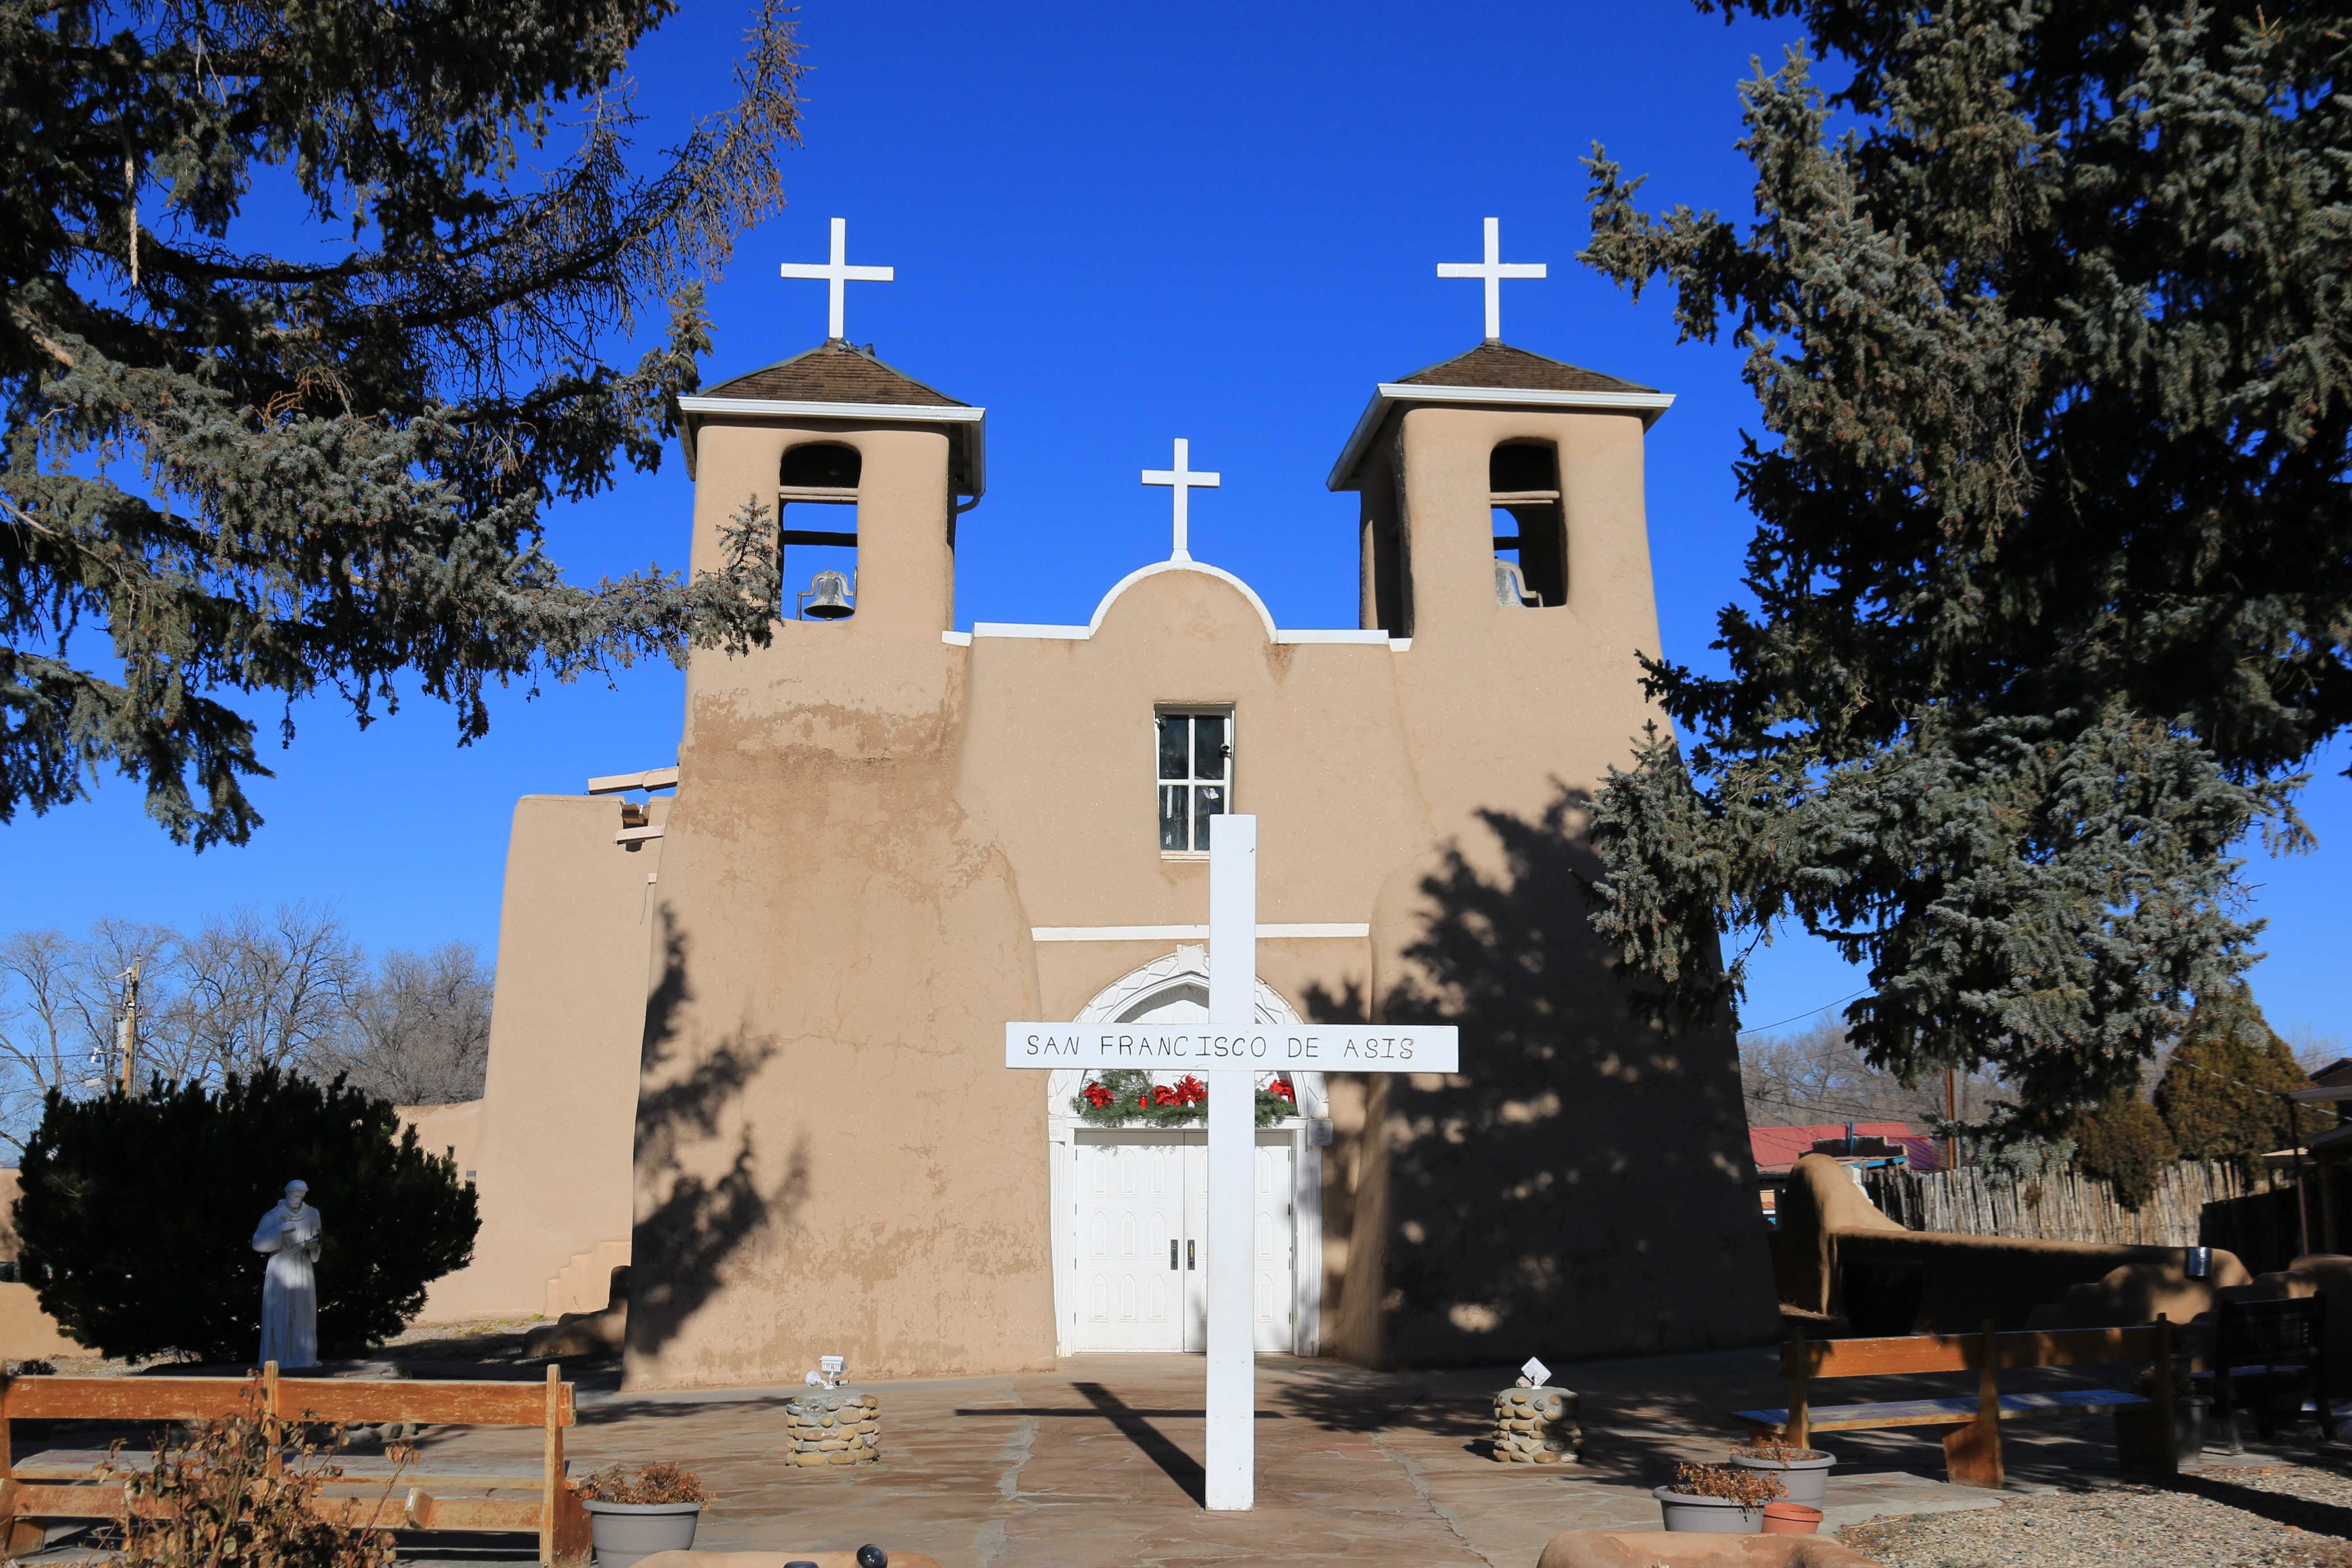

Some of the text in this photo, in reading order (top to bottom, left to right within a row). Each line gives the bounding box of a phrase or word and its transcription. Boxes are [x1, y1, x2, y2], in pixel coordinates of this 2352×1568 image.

[1026, 1035, 1414, 1059] SAN FRANCISCO DE ASIS
